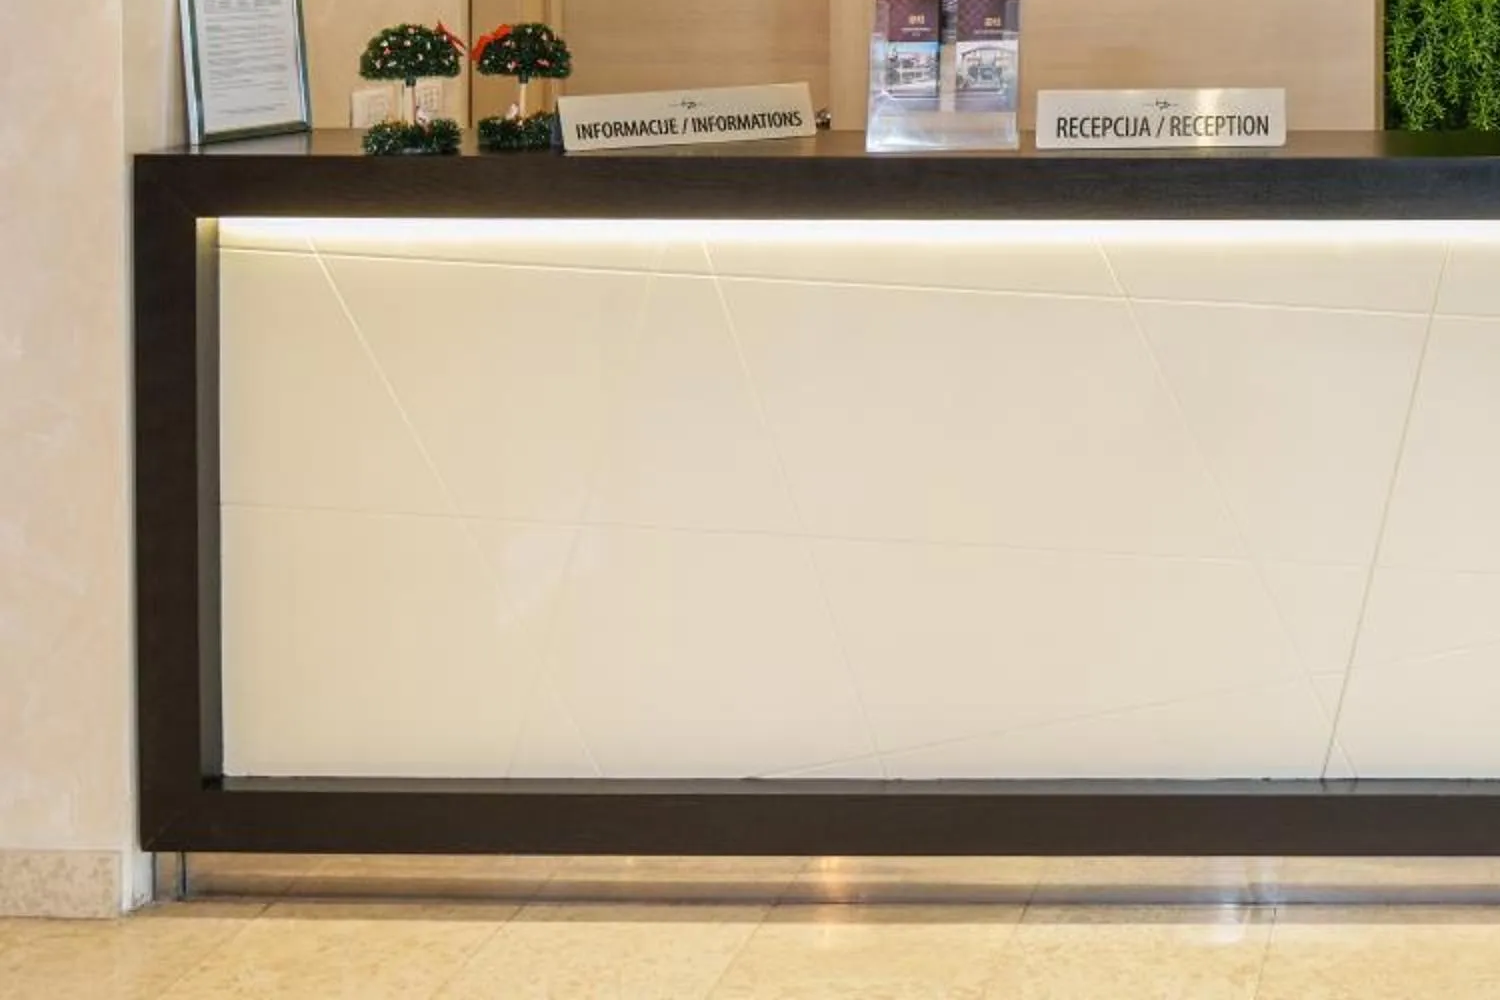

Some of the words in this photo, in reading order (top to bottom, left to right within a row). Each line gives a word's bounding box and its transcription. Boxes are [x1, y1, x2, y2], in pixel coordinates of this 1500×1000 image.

[575, 117, 678, 140] INFORMACIJE
[682, 116, 689, 134] /
[692, 111, 802, 133] INFORMATIONS
[1056, 116, 1150, 139] RECEPCIJA
[1156, 116, 1165, 138] /
[1170, 115, 1269, 137] RECEPTION
